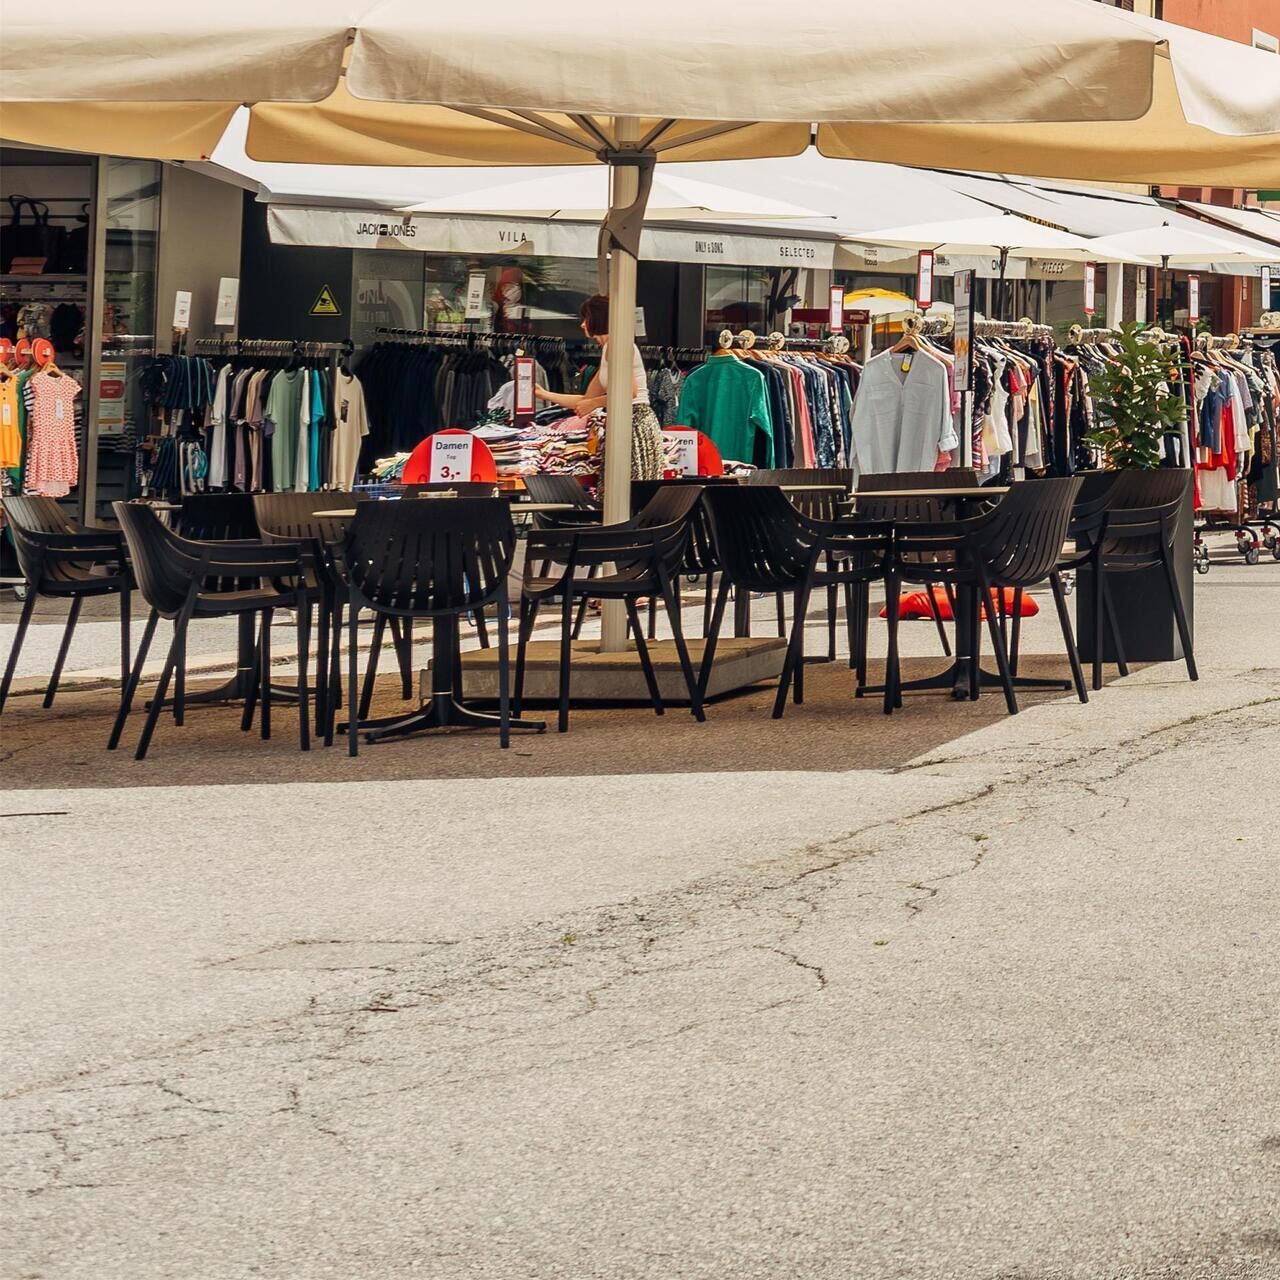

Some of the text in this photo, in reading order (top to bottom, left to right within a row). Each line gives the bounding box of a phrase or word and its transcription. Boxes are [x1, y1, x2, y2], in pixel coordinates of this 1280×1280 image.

[499, 231, 527, 242] VILA
[780, 246, 815, 258] SELECTED
[435, 442, 469, 450] Damen
